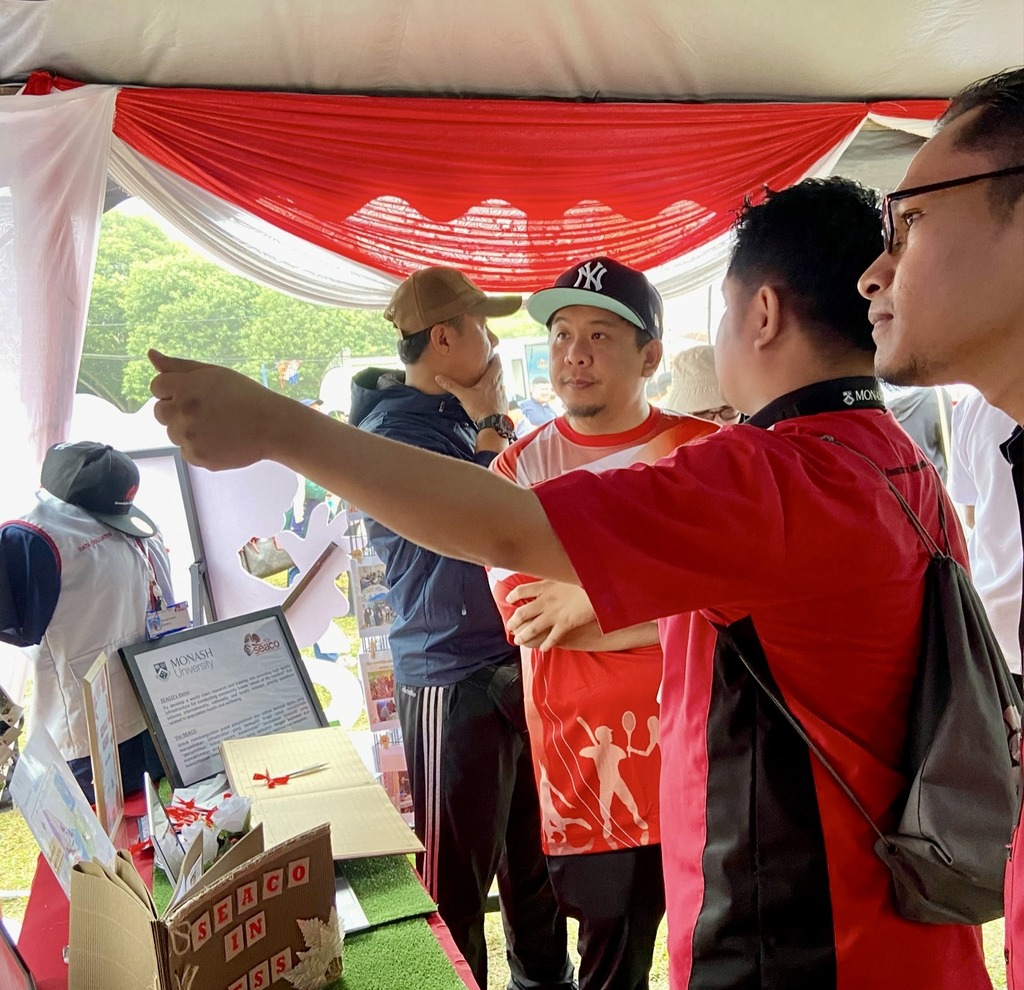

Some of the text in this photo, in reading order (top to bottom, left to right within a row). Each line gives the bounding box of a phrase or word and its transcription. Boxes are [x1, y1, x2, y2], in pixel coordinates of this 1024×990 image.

[253, 640, 280, 655] seaco
[169, 648, 213, 668] MONASH
[173, 659, 215, 678] University
[197, 865, 306, 941] SEACO
[231, 918, 263, 951] IN
